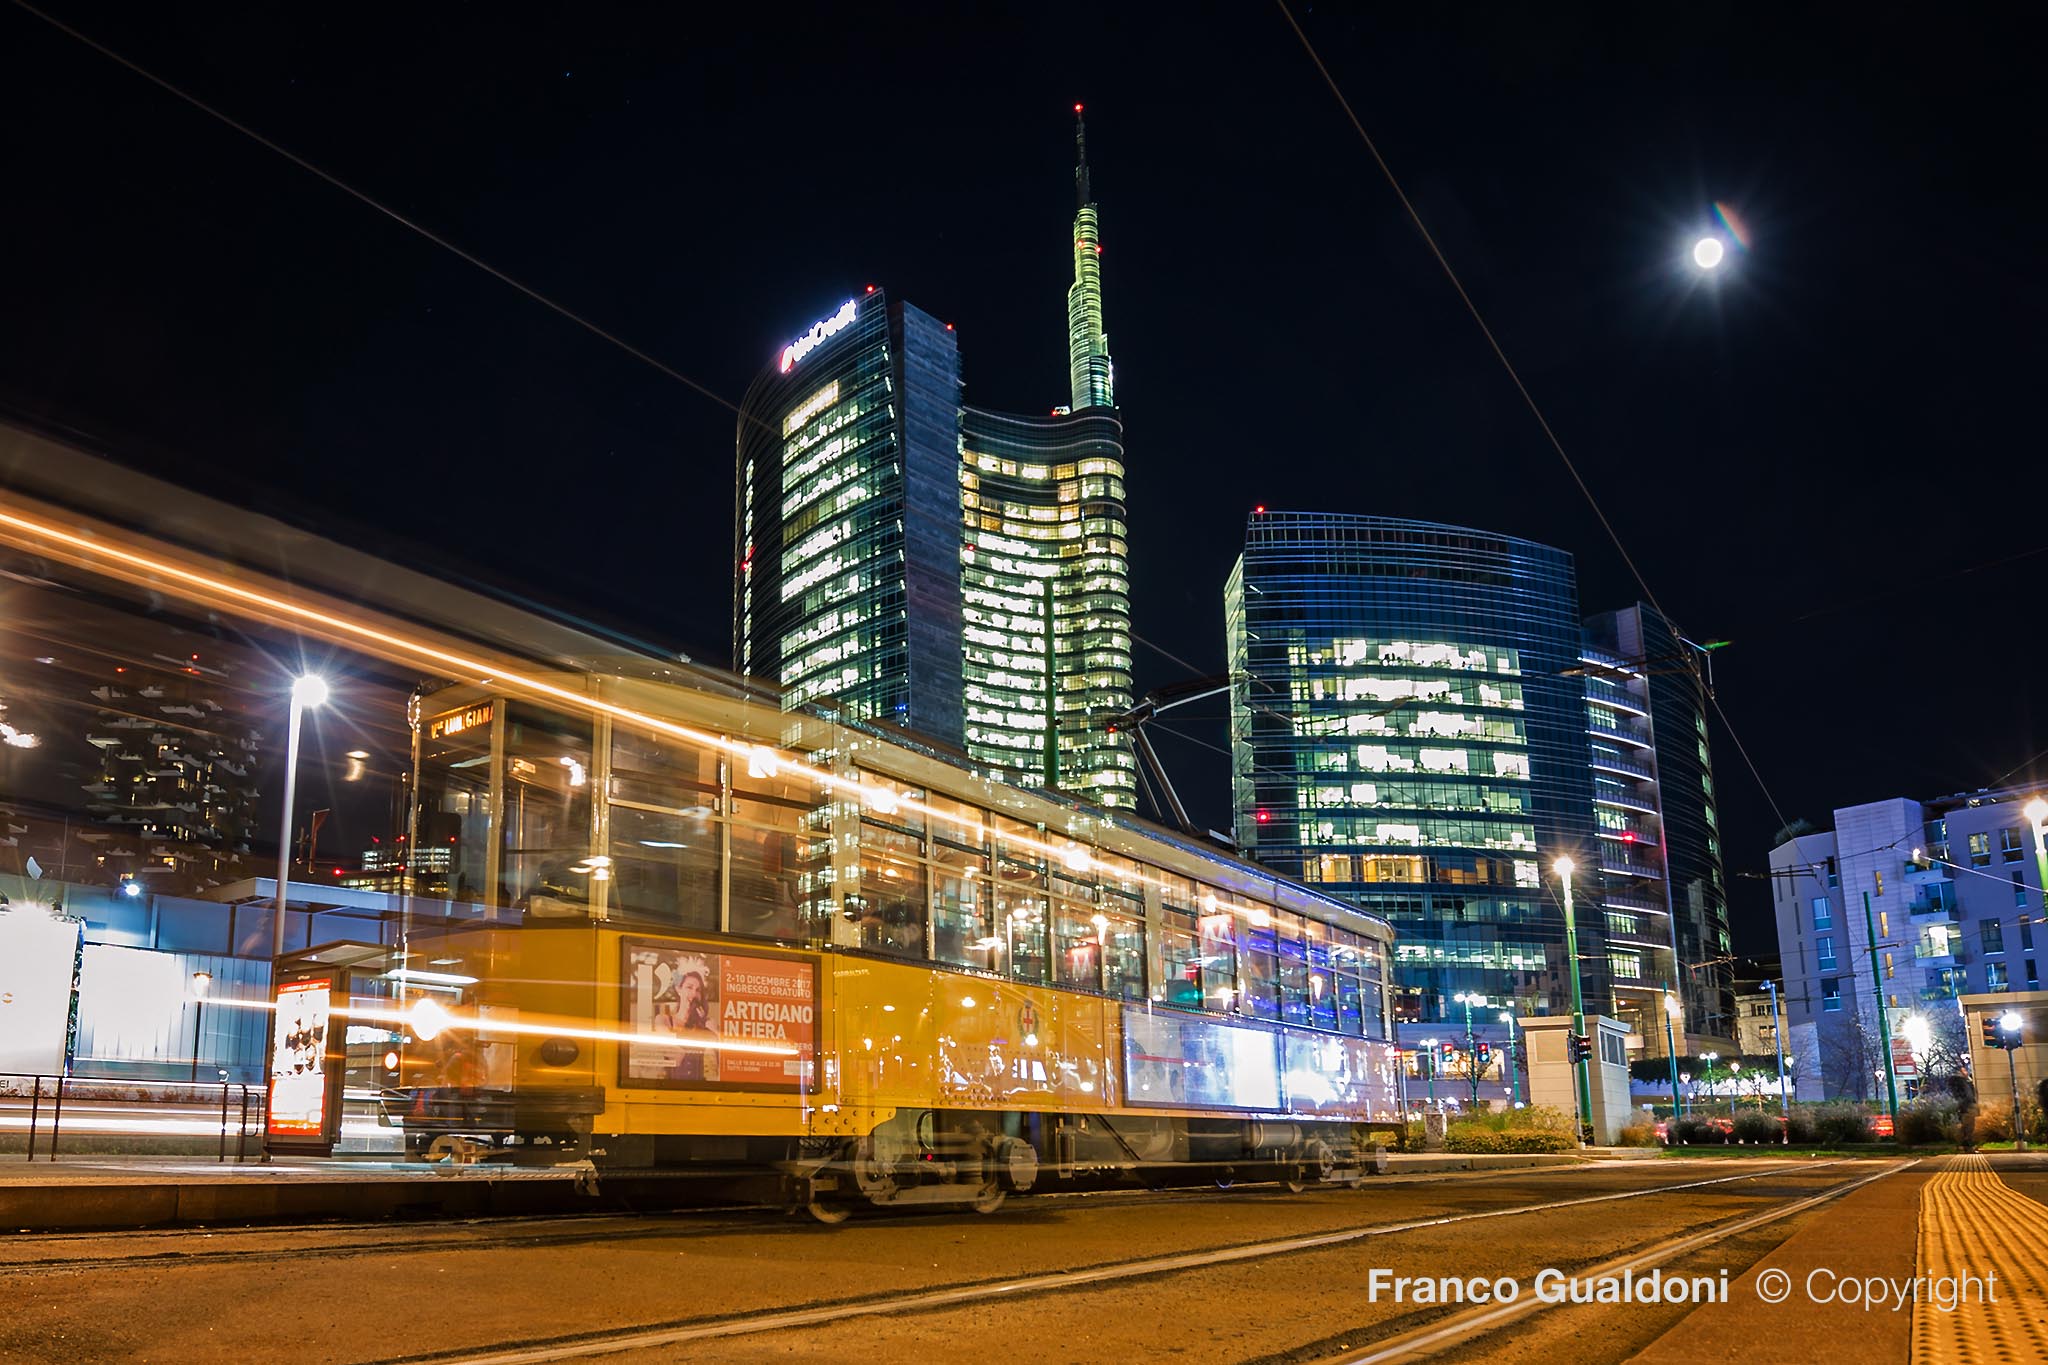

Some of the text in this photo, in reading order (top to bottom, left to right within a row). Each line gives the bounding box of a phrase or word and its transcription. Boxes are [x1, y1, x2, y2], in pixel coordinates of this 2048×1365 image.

[726, 973, 745, 983] 2-10
[747, 975, 790, 988] DICEMBRE
[726, 983, 811, 999] INGRESSO GRATUITO
[724, 1000, 813, 1024] ARTIGIANO
[724, 1020, 786, 1040] IN FIERA
